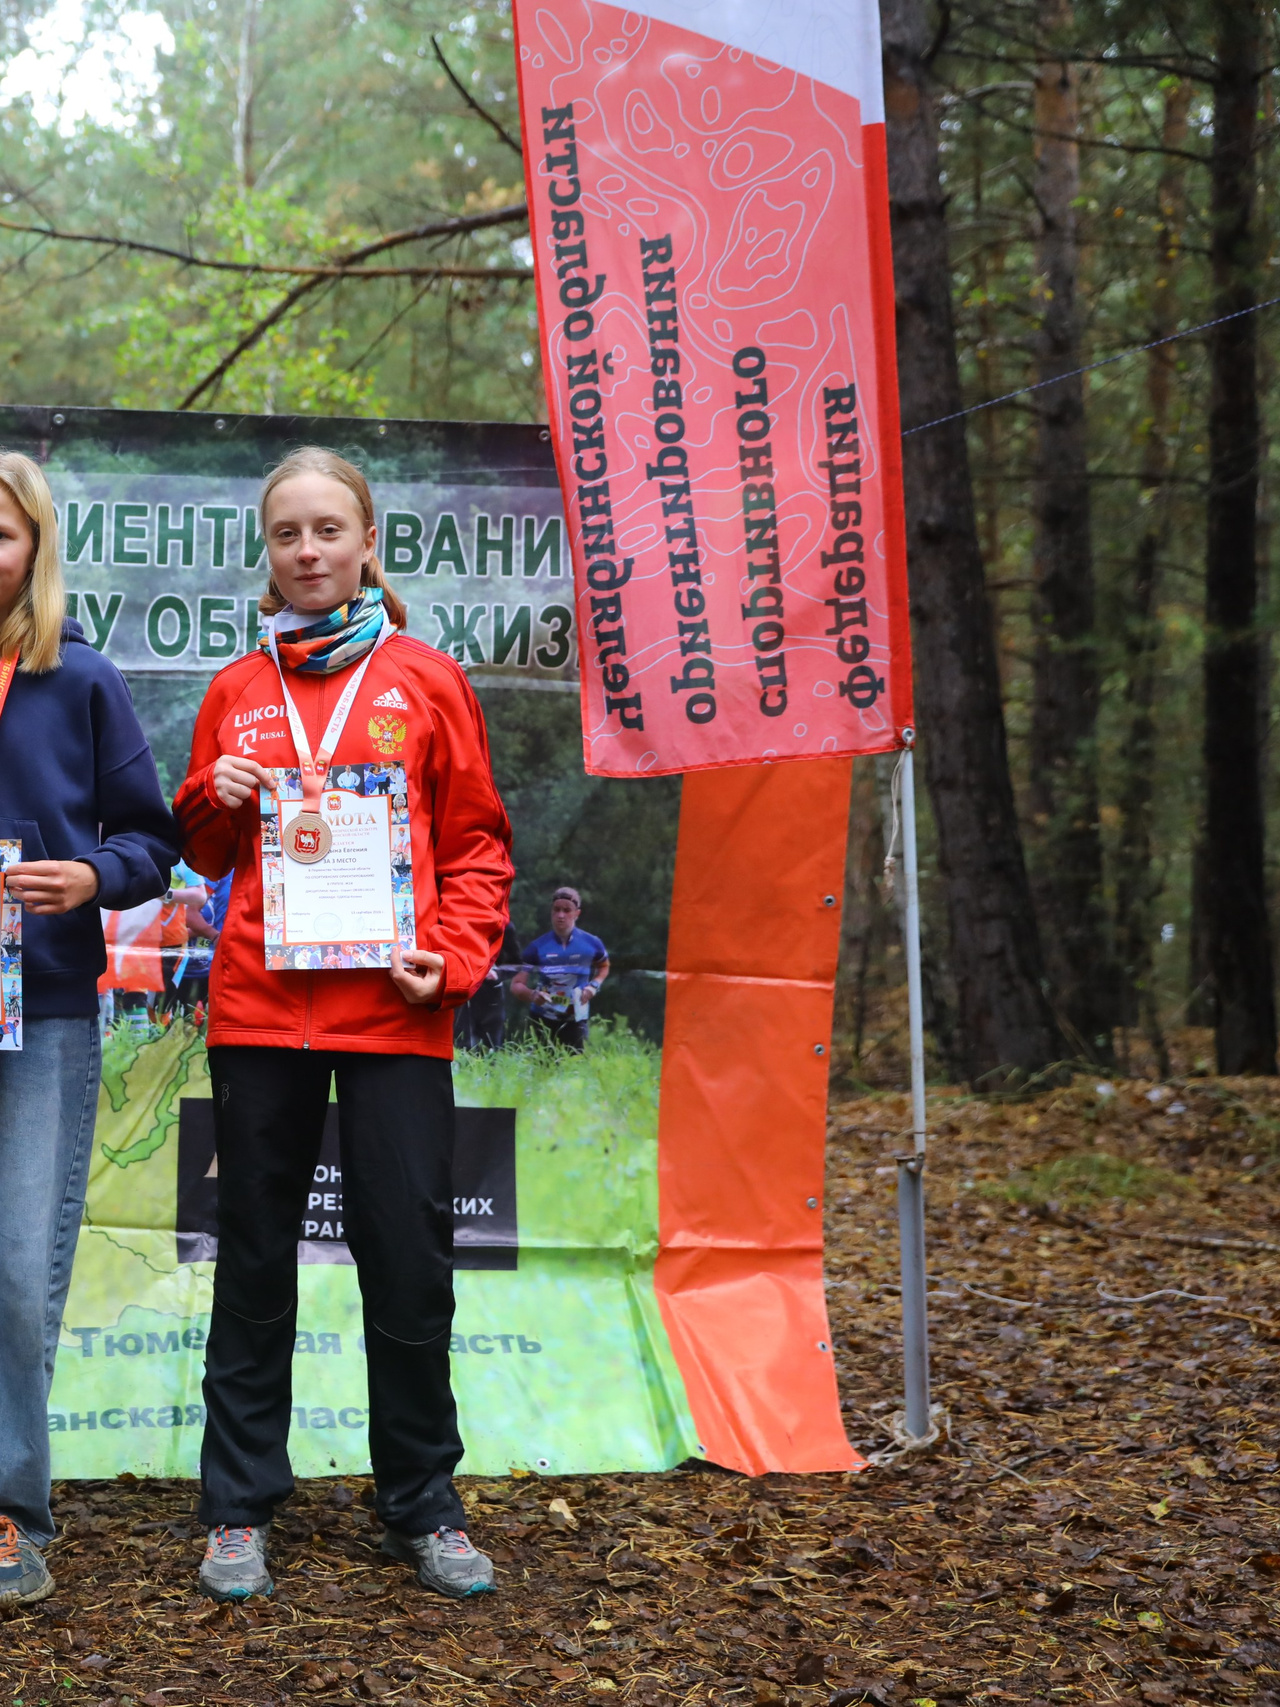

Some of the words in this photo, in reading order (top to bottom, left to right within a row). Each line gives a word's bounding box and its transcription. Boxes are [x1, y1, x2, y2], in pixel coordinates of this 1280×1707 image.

[431, 602, 580, 671] ЖИЗ
[330, 691, 352, 734] ОБЛАСТЬ
[372, 699, 408, 711] adidas
[234, 704, 289, 728] LUKOI
[260, 731, 287, 740] RUSAL
[325, 811, 377, 827] МОТА
